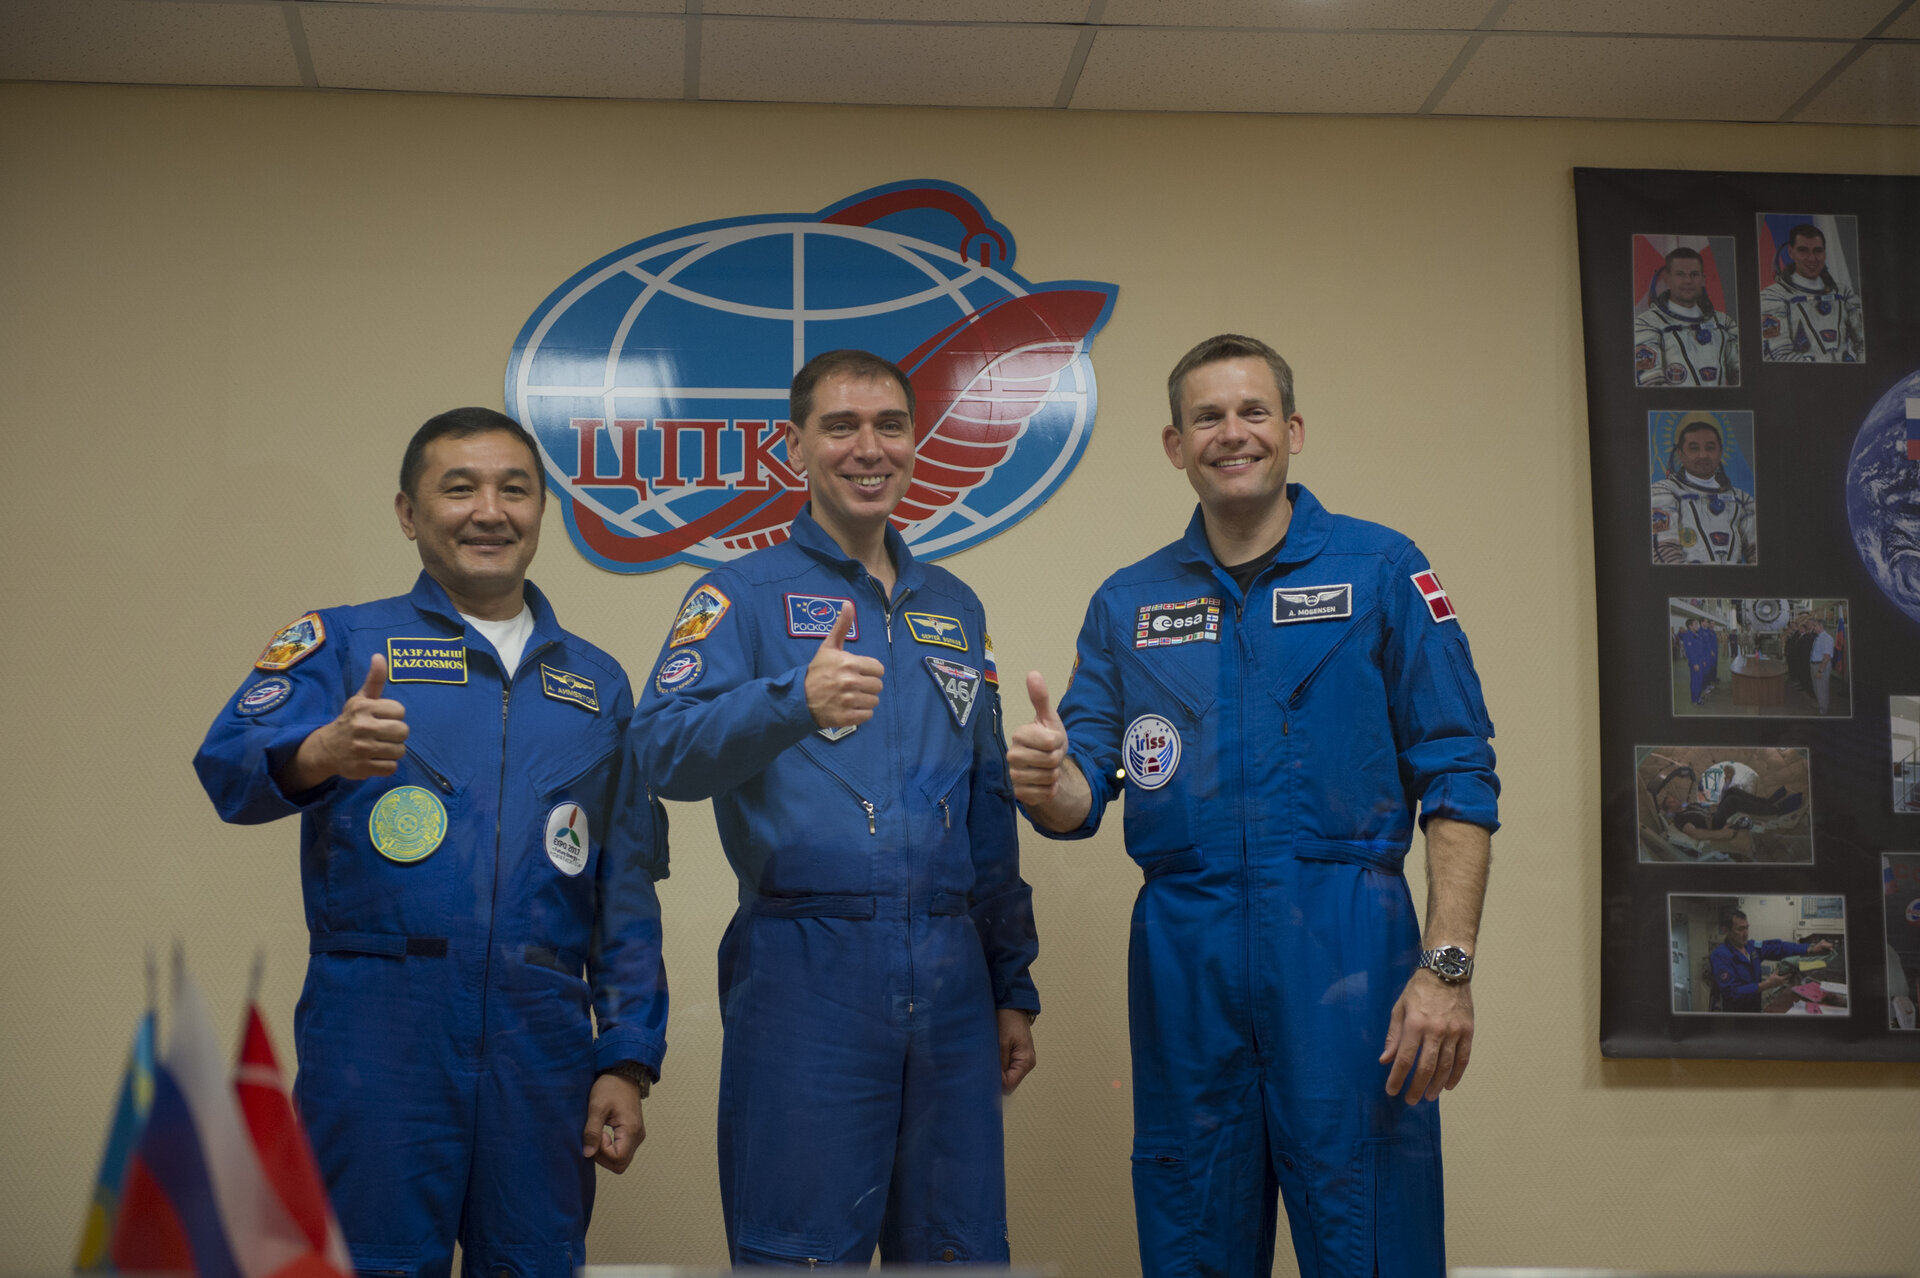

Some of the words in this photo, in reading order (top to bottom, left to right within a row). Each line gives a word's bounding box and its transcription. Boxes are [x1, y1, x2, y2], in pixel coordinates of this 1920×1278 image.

[570, 418, 808, 501] ЦПК
[1288, 609, 1296, 617] A.
[1298, 606, 1336, 616] MOGENSEN
[392, 648, 463, 658] ҚАЗҒАРЫШ
[393, 659, 464, 670] KAZCOSMOS
[945, 677, 970, 702] 46
[1135, 733, 1166, 751] iriss
[553, 838, 567, 849] EXPO
